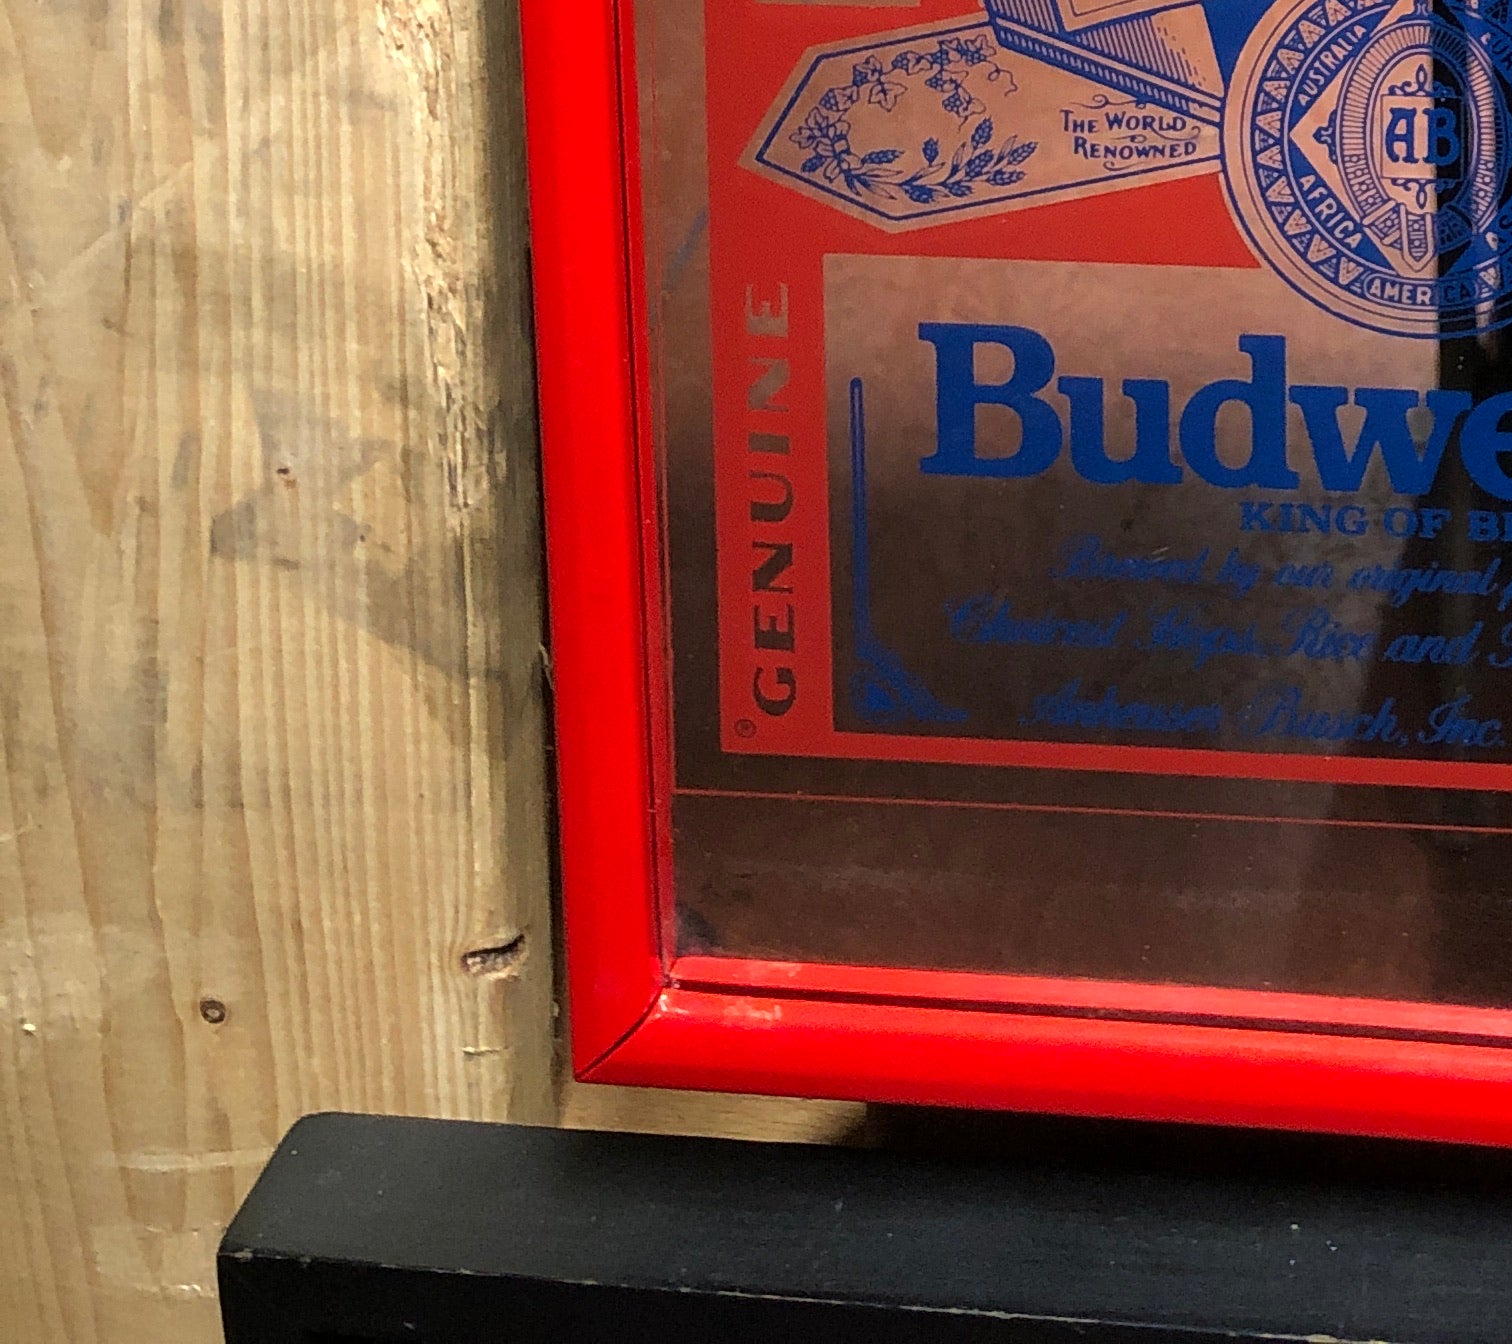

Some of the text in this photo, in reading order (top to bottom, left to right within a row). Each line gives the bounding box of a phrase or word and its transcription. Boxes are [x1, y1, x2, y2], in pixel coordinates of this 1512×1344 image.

[1299, 25, 1368, 105] AUSTRALIA
[1061, 108, 1189, 135] THE WORLD
[1073, 134, 1198, 160] RENOWNED
[1385, 107, 1460, 166] AB
[1300, 174, 1363, 249] AFRICA
[1368, 282, 1474, 306] AMERICA
[743, 281, 798, 717] GENUINE
[1239, 501, 1367, 538] KING
[1381, 507, 1452, 542] OF
[1048, 533, 1212, 587] Brewed
[1216, 547, 1263, 602] by
[1274, 559, 1335, 588] our
[1349, 554, 1502, 609] original
[940, 587, 1130, 650] Choicest
[1271, 602, 1380, 662] Rice
[1385, 621, 1484, 664] and
[1418, 694, 1505, 748] Inc.
